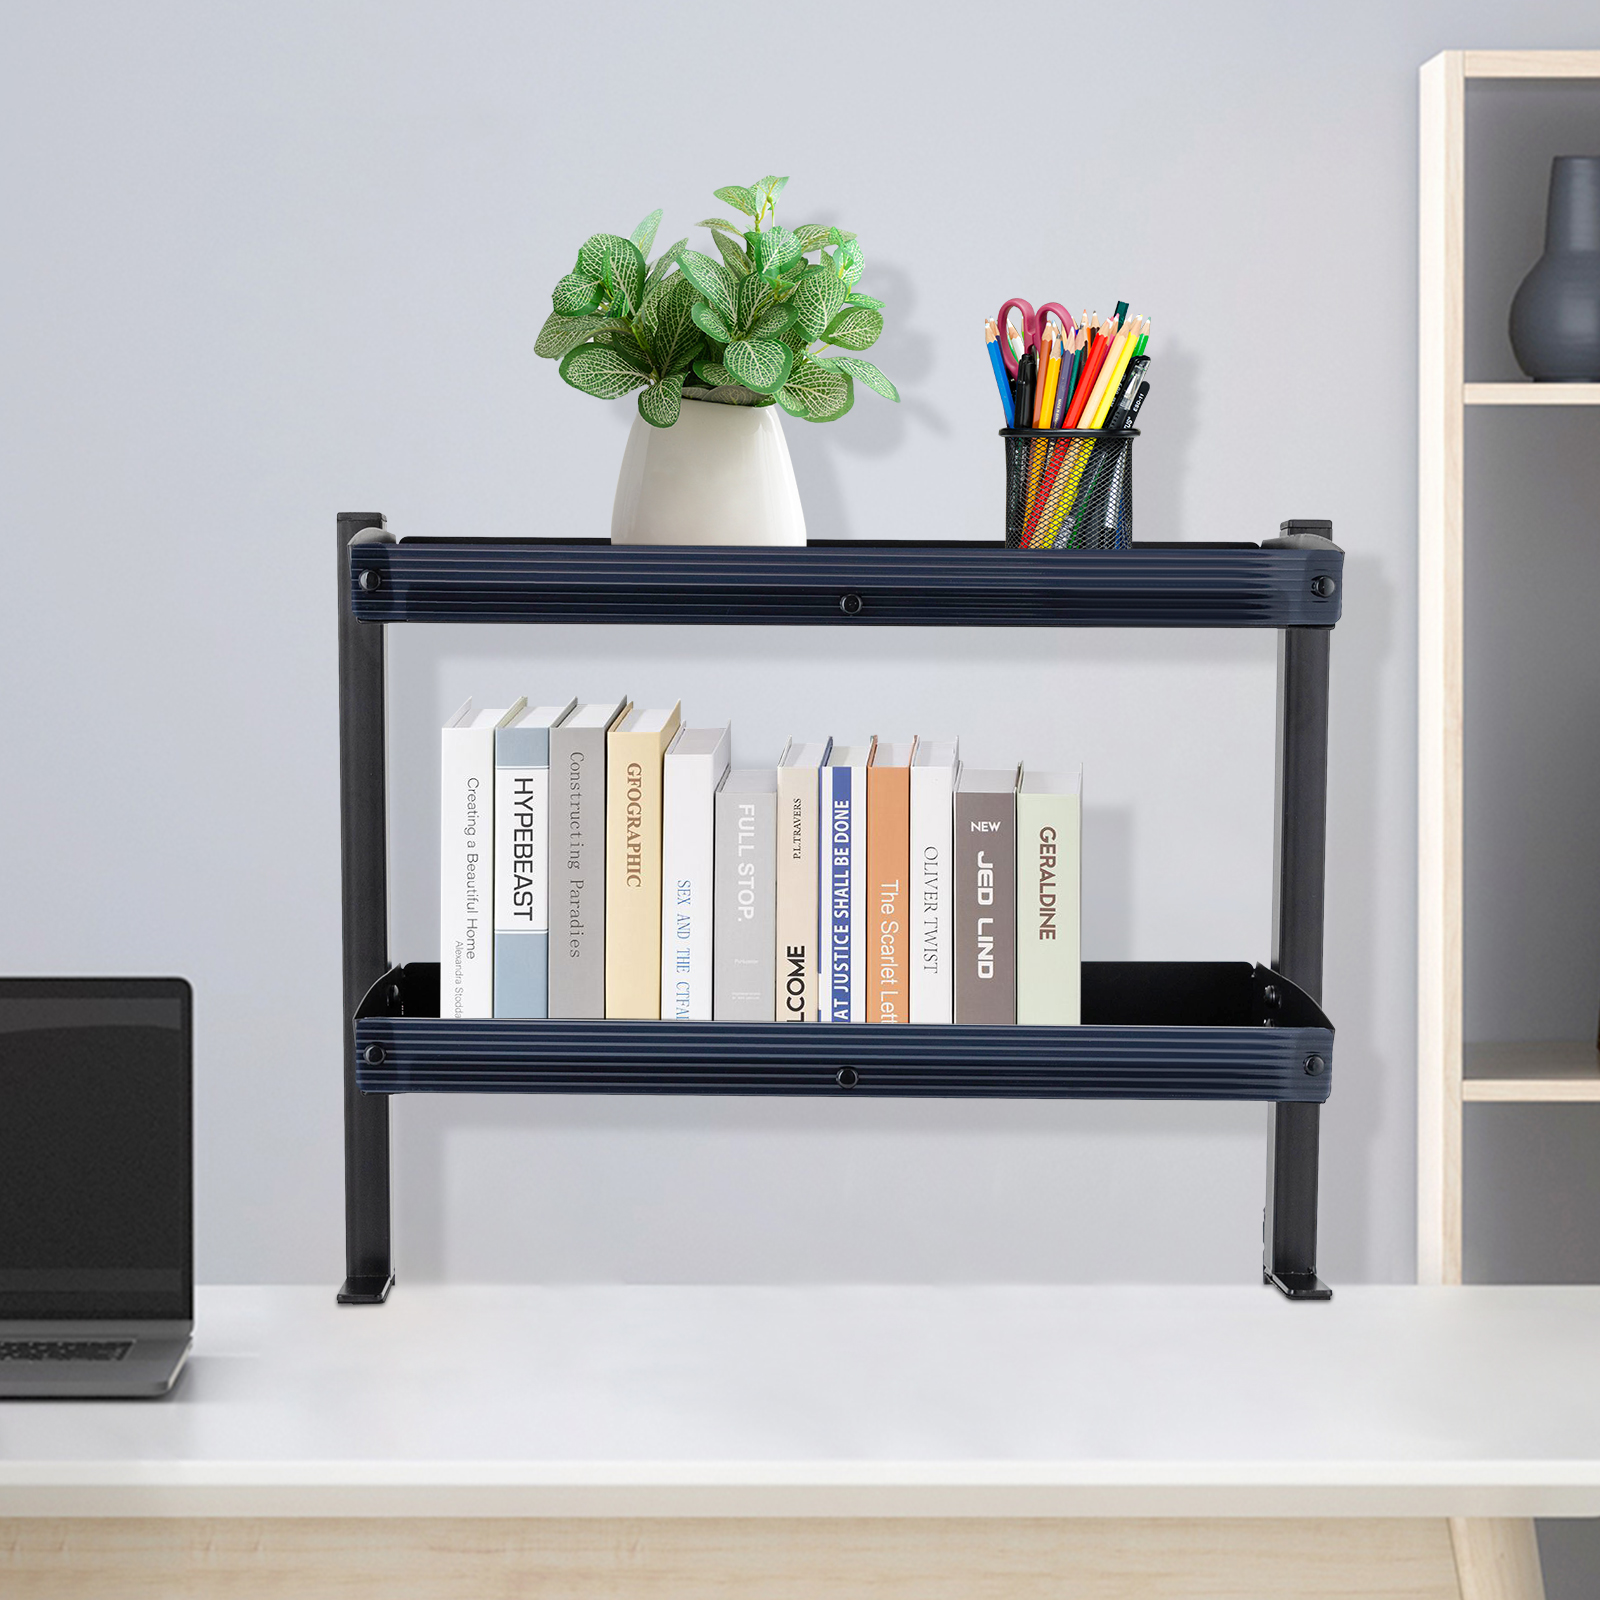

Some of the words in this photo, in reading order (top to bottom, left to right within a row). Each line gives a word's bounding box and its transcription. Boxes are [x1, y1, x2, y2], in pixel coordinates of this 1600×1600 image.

[464, 777, 480, 836] Creating
[567, 751, 585, 870] Constructing
[626, 762, 643, 888] GFOGRAPHIC
[738, 804, 755, 857] FULL
[833, 800, 850, 843] DONE
[970, 821, 1001, 832] NEW
[466, 840, 476, 849] a
[513, 778, 534, 921] HYPEBEAST
[833, 847, 850, 866] BE
[466, 853, 479, 914] Beautiful
[676, 879, 691, 905] SEX
[737, 862, 755, 922] STOP.
[833, 869, 850, 919] SHALL
[880, 879, 899, 915] The
[923, 846, 939, 913] OLIVER
[977, 850, 994, 906] JED
[1039, 826, 1057, 940] GERALDINE
[466, 918, 478, 960] Home
[569, 879, 585, 958] Paradies
[676, 913, 691, 940] AND
[923, 917, 939, 974] TWIST
[454, 940, 465, 985] Alexandra
[676, 948, 691, 974] THE
[833, 925, 850, 993] JUSTICE
[880, 920, 899, 985] Scarlet
[977, 917, 994, 979] LIND
